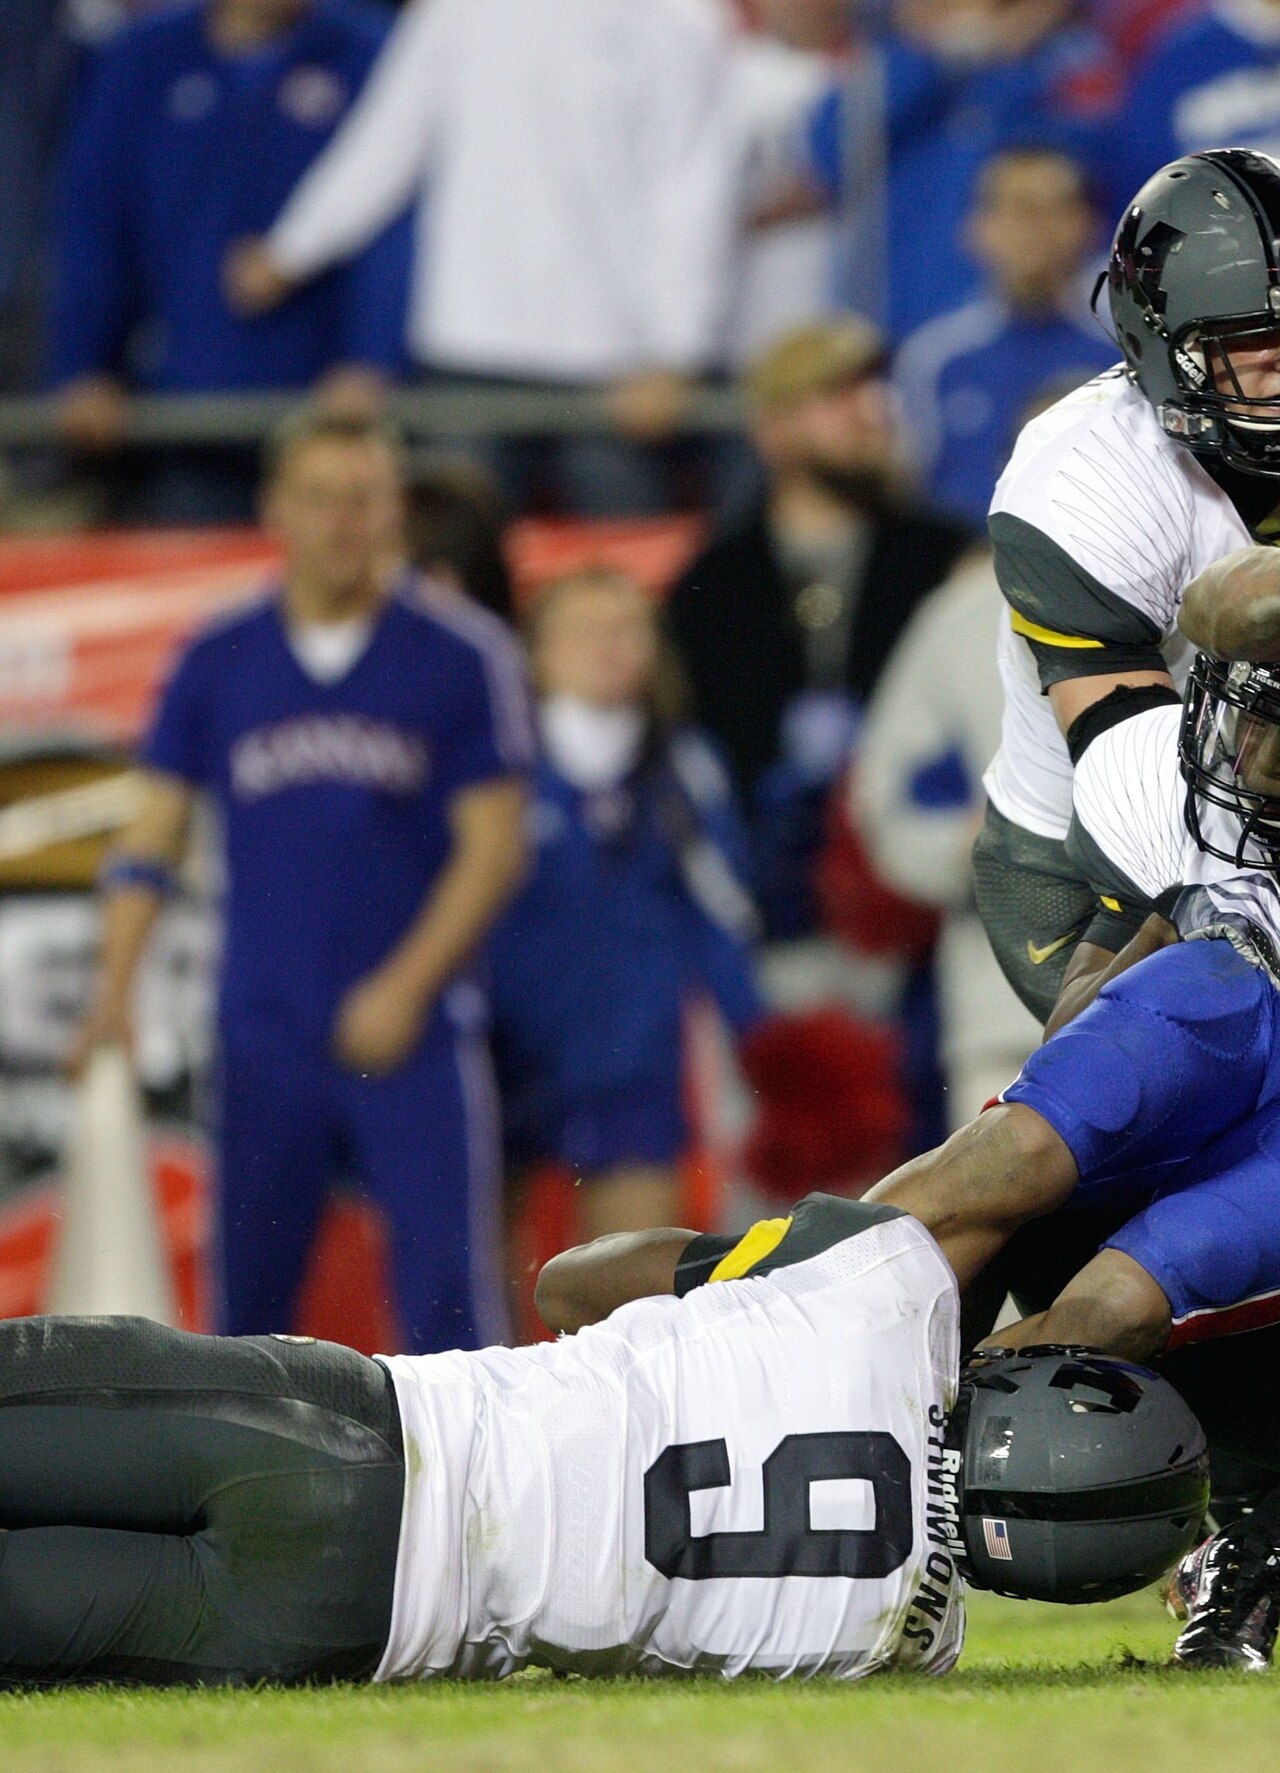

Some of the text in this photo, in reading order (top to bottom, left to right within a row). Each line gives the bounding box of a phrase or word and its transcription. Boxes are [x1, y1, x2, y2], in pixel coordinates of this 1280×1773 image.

[1174, 348, 1206, 387] ddell
[644, 1431, 912, 1580] 9
[903, 1404, 952, 1651] SIMMONS
[941, 1449, 968, 1557] Riddell
